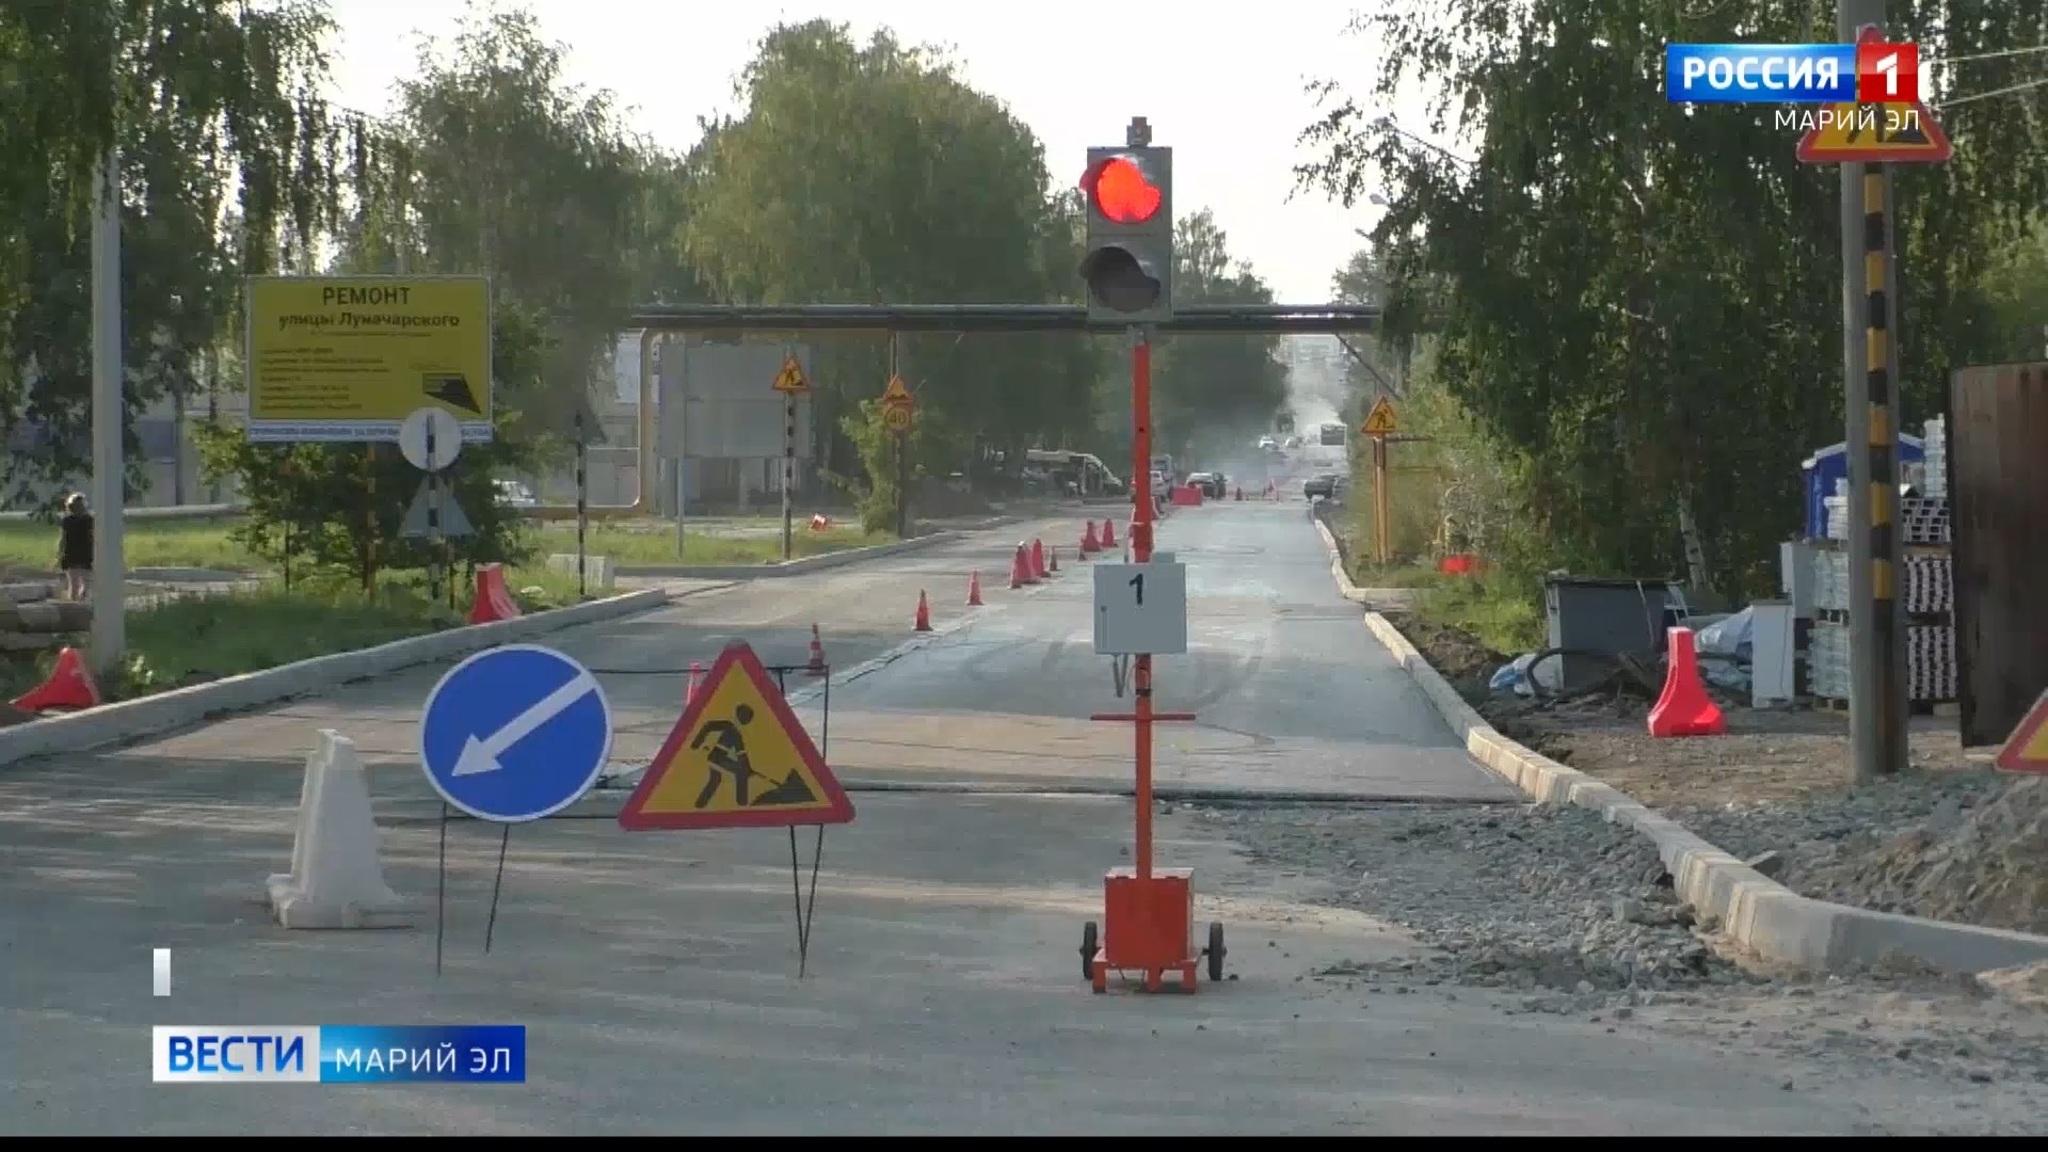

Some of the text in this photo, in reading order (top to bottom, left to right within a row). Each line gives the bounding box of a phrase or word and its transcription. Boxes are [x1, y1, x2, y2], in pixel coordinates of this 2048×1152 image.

[323, 287, 411, 306] РЕМОНТ
[279, 312, 460, 331] улицы Луначарского
[888, 410, 907, 424] 40
[1128, 573, 1144, 606] 1
